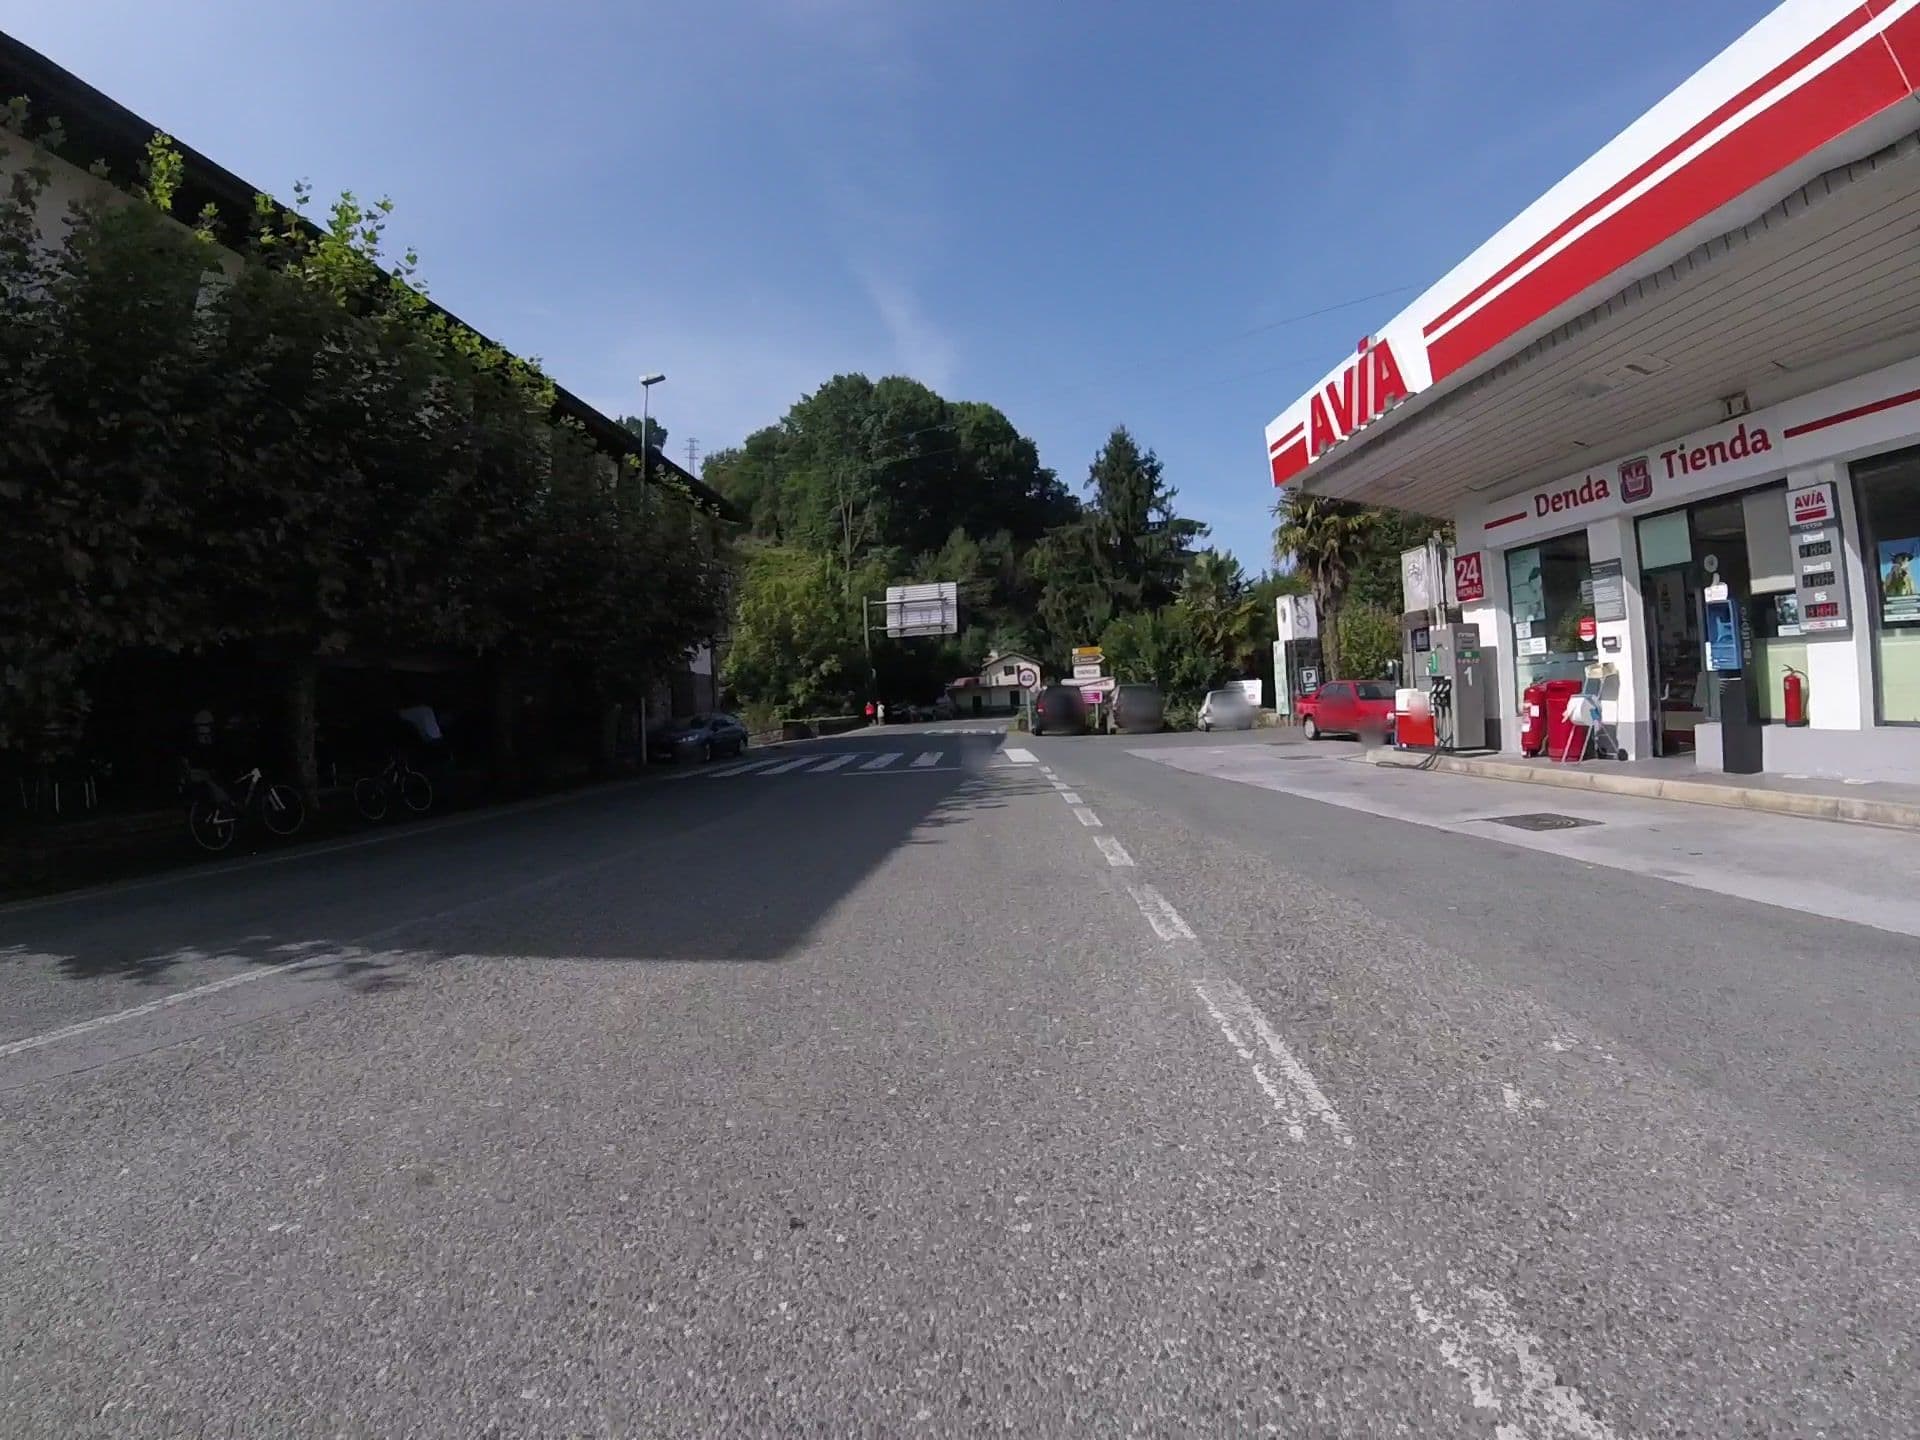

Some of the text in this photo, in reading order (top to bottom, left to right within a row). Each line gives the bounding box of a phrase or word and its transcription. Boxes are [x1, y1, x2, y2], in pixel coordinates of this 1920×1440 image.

[1311, 335, 1409, 457] AVIA
[1534, 424, 1772, 517] Denda Tienda
[1794, 490, 1825, 509] AVIA
[1457, 557, 1480, 587] 24
[1457, 586, 1482, 598] HORAS
[1306, 672, 1313, 681] P
[1464, 666, 1473, 686] 1
